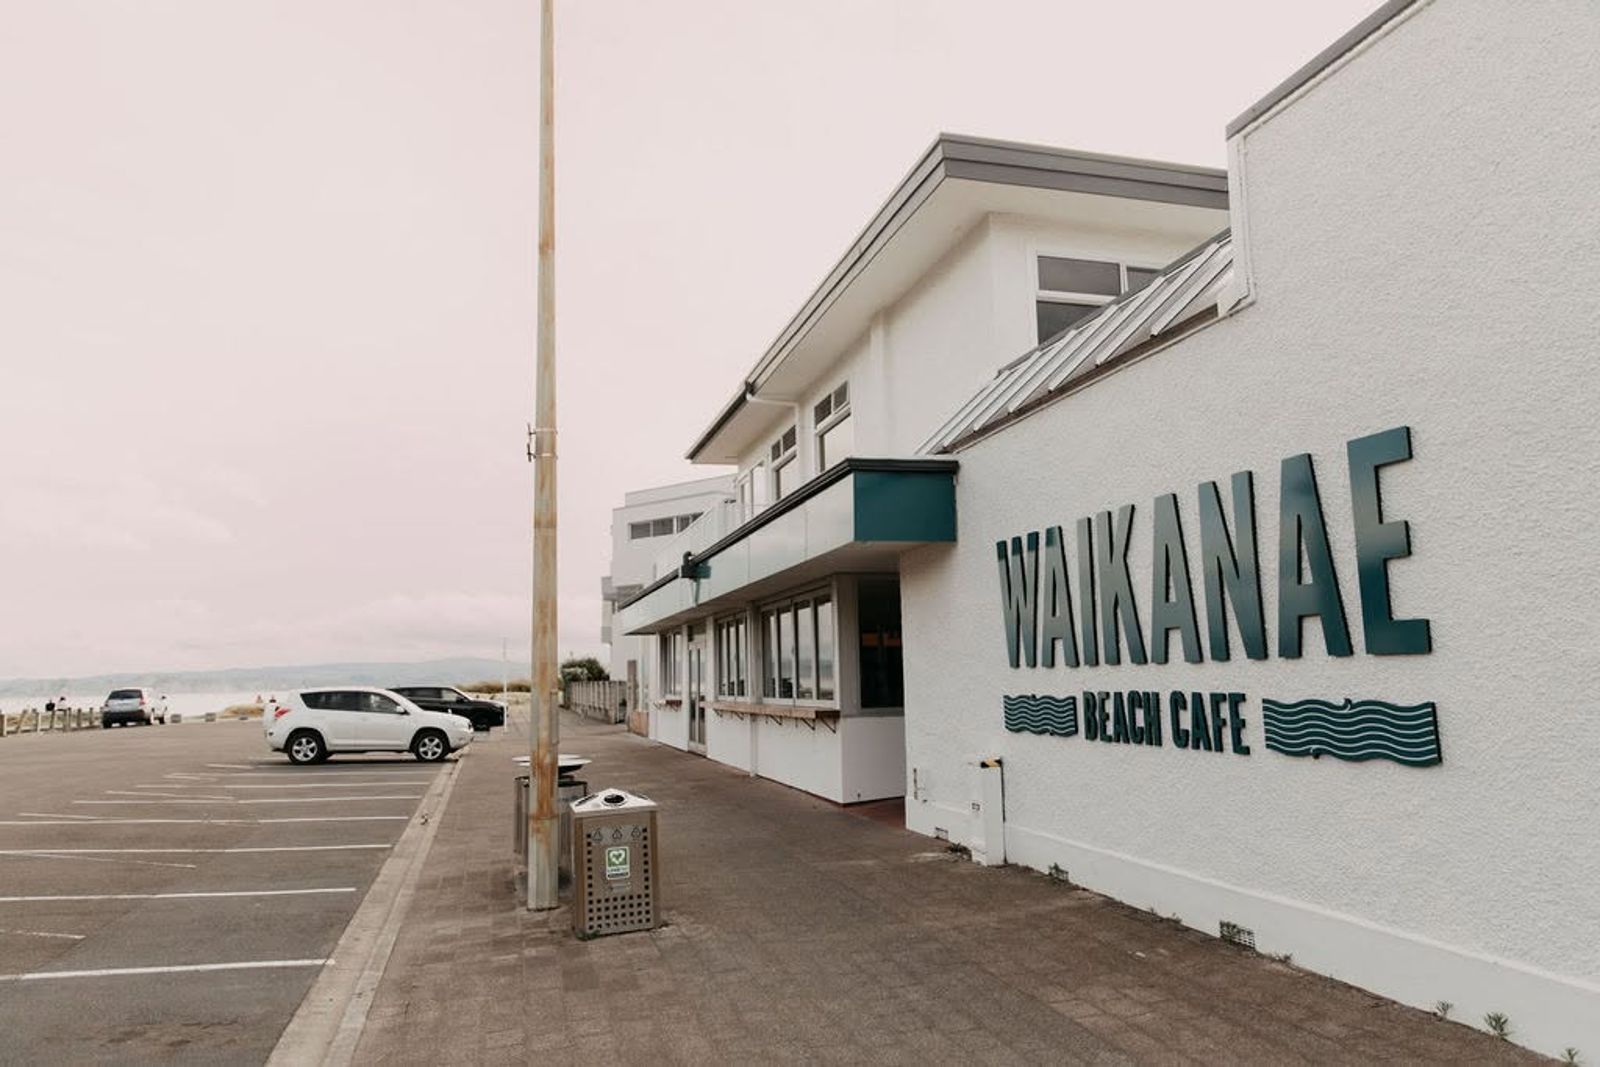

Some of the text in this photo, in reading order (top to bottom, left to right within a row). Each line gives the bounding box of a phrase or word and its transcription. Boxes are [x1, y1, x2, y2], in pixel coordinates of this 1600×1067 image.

[996, 426, 1432, 669] WAIKANAE
[1083, 690, 1251, 755] BEACH CAFE
